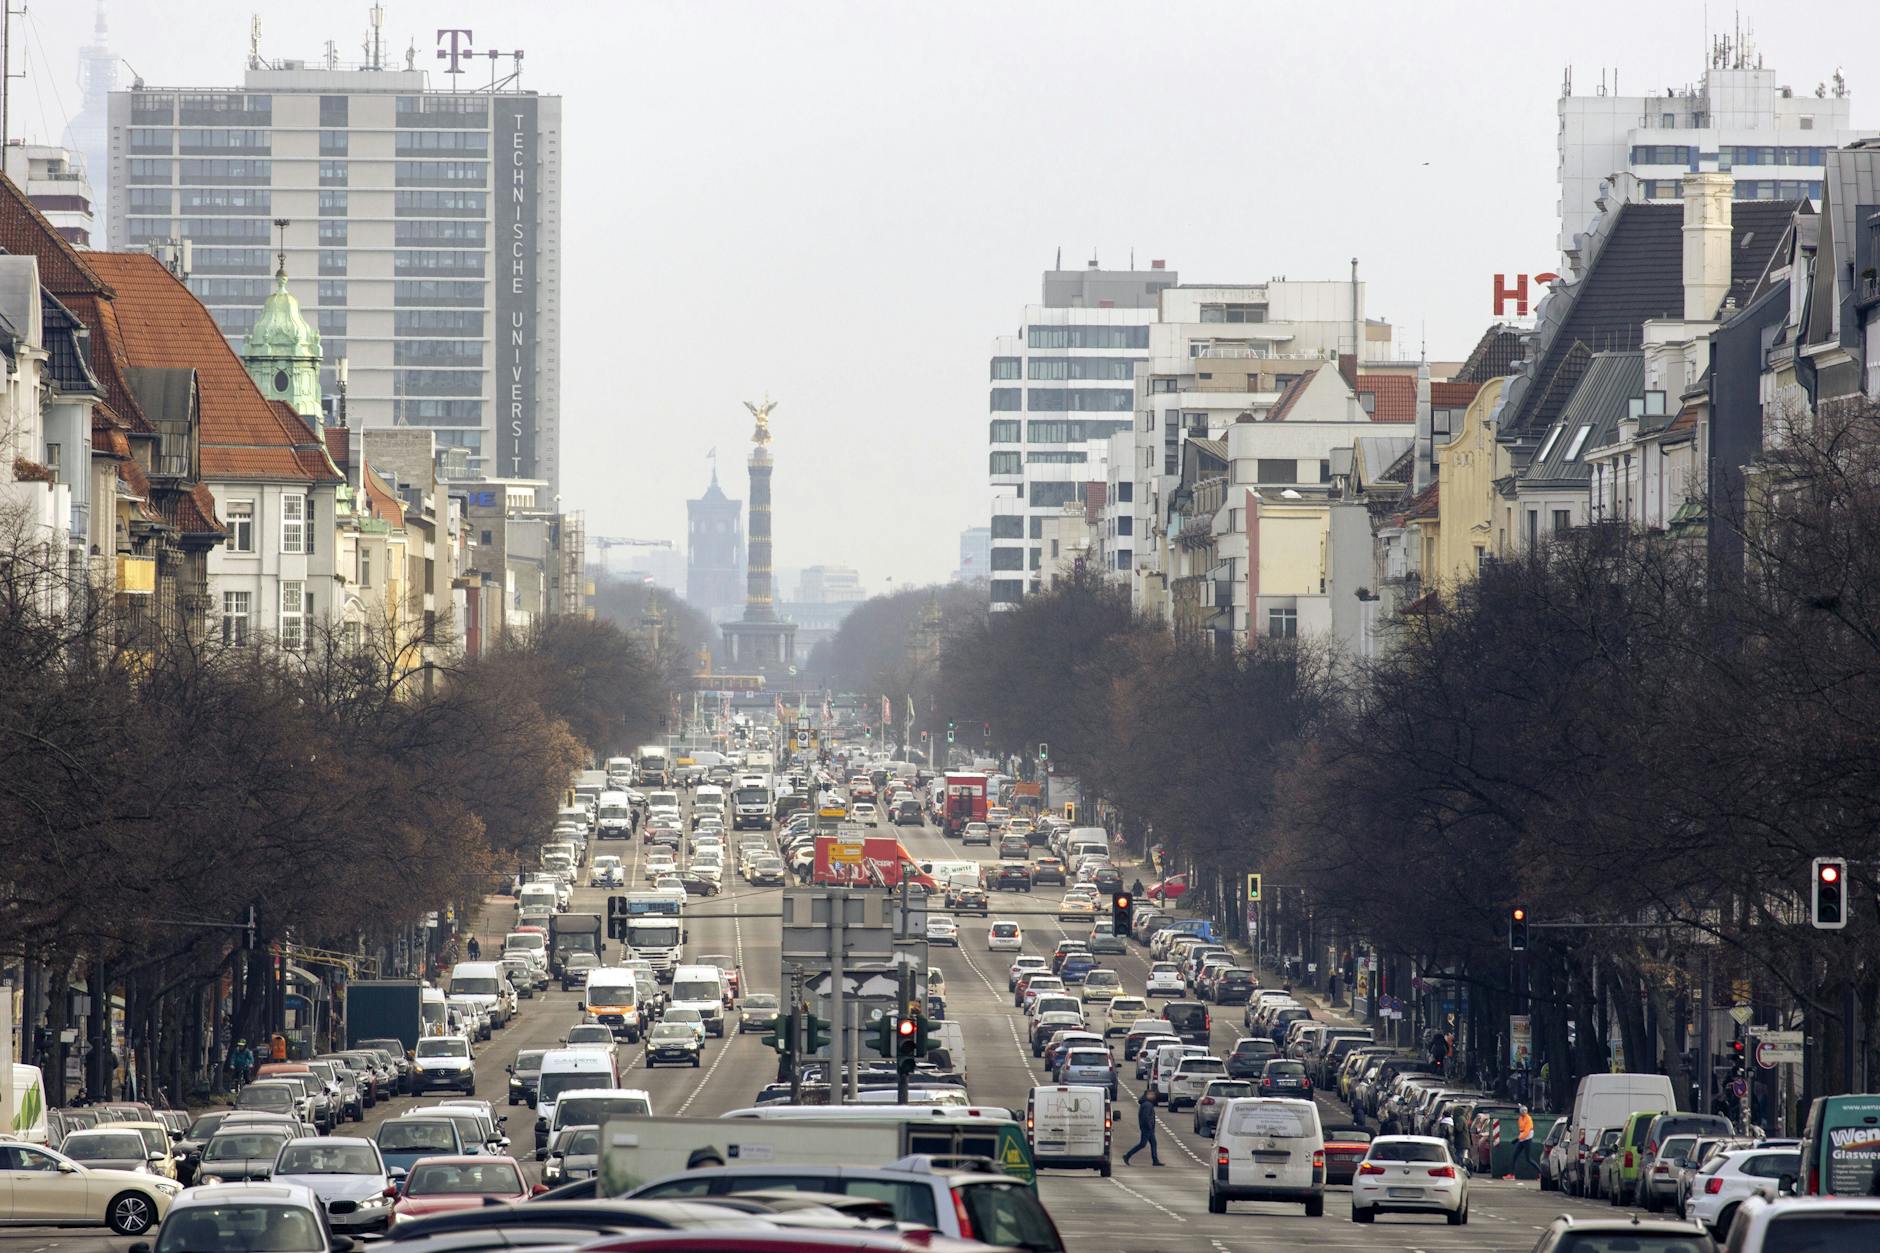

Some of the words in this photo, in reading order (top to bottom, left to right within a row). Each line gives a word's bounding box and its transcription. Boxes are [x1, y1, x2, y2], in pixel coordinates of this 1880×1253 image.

[512, 114, 524, 294] TECHNISCHE
[511, 311, 523, 479] UNIVERSIT
[1046, 1097, 1092, 1113] HAJO
